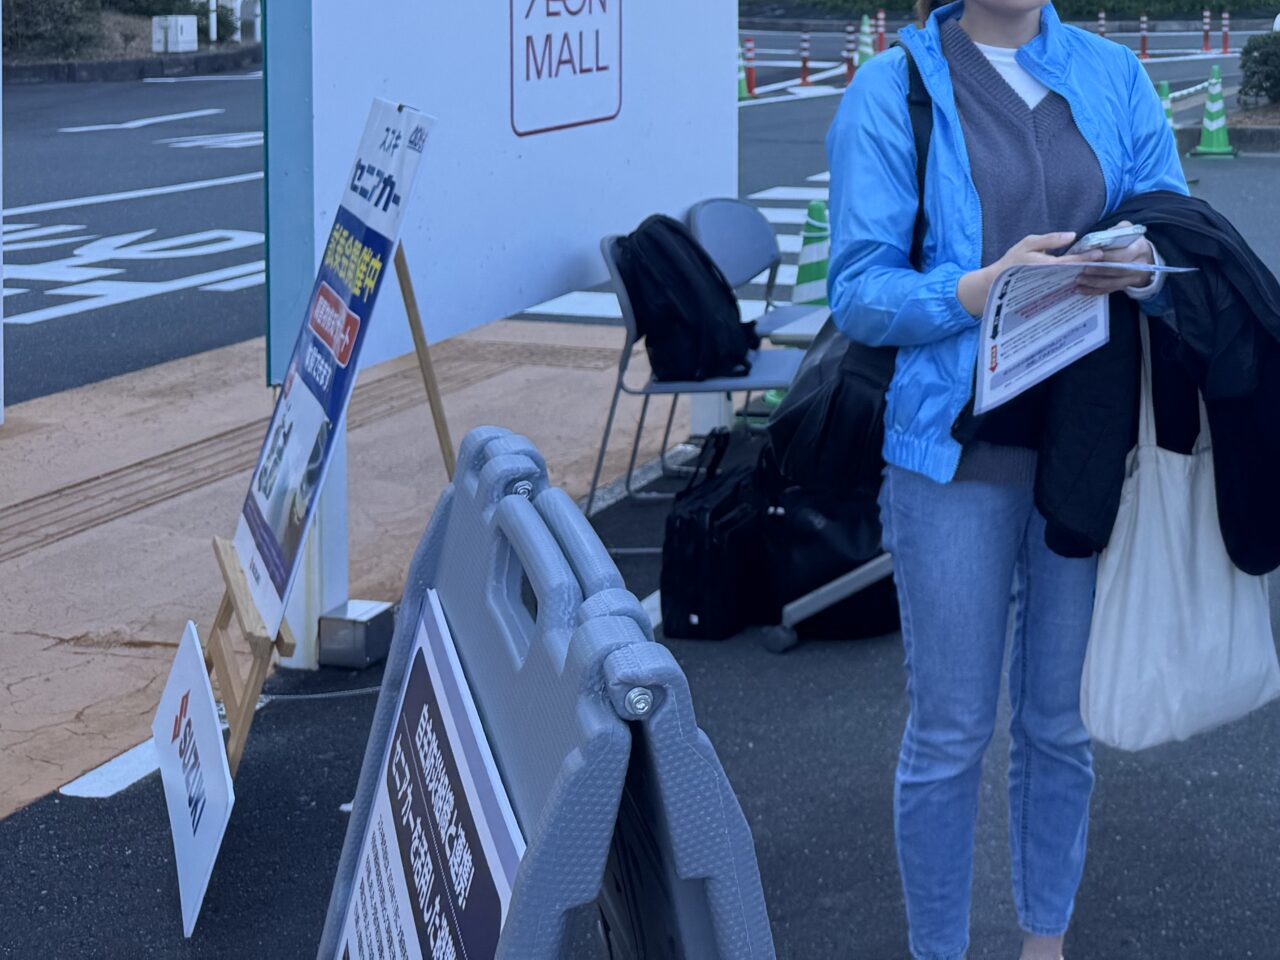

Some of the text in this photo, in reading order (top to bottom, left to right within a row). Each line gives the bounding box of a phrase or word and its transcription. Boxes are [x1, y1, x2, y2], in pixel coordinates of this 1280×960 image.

[525, 29, 609, 81] MALL
[350, 157, 401, 212] セニアカー
[178, 717, 206, 837] SUZUKI
